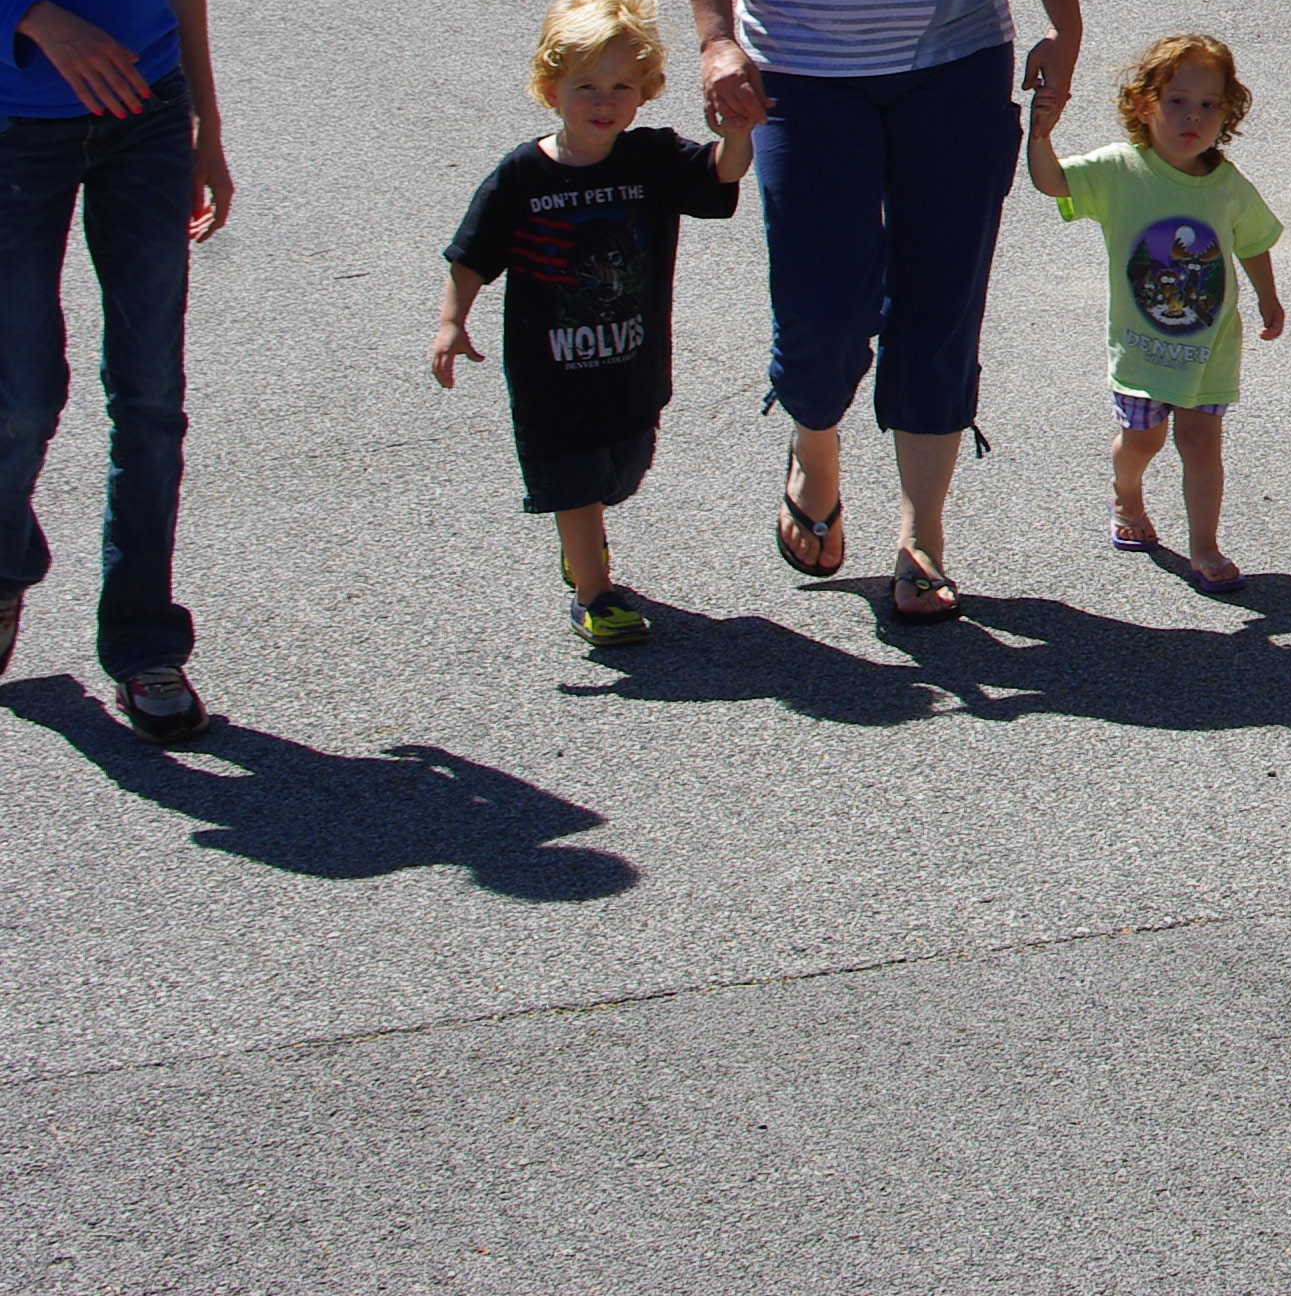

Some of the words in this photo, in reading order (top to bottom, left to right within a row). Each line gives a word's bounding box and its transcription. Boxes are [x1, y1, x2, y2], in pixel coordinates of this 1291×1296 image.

[530, 191, 579, 213] DON'T
[585, 186, 614, 205] PET
[618, 184, 645, 201] THE
[549, 314, 646, 363] WOLVES
